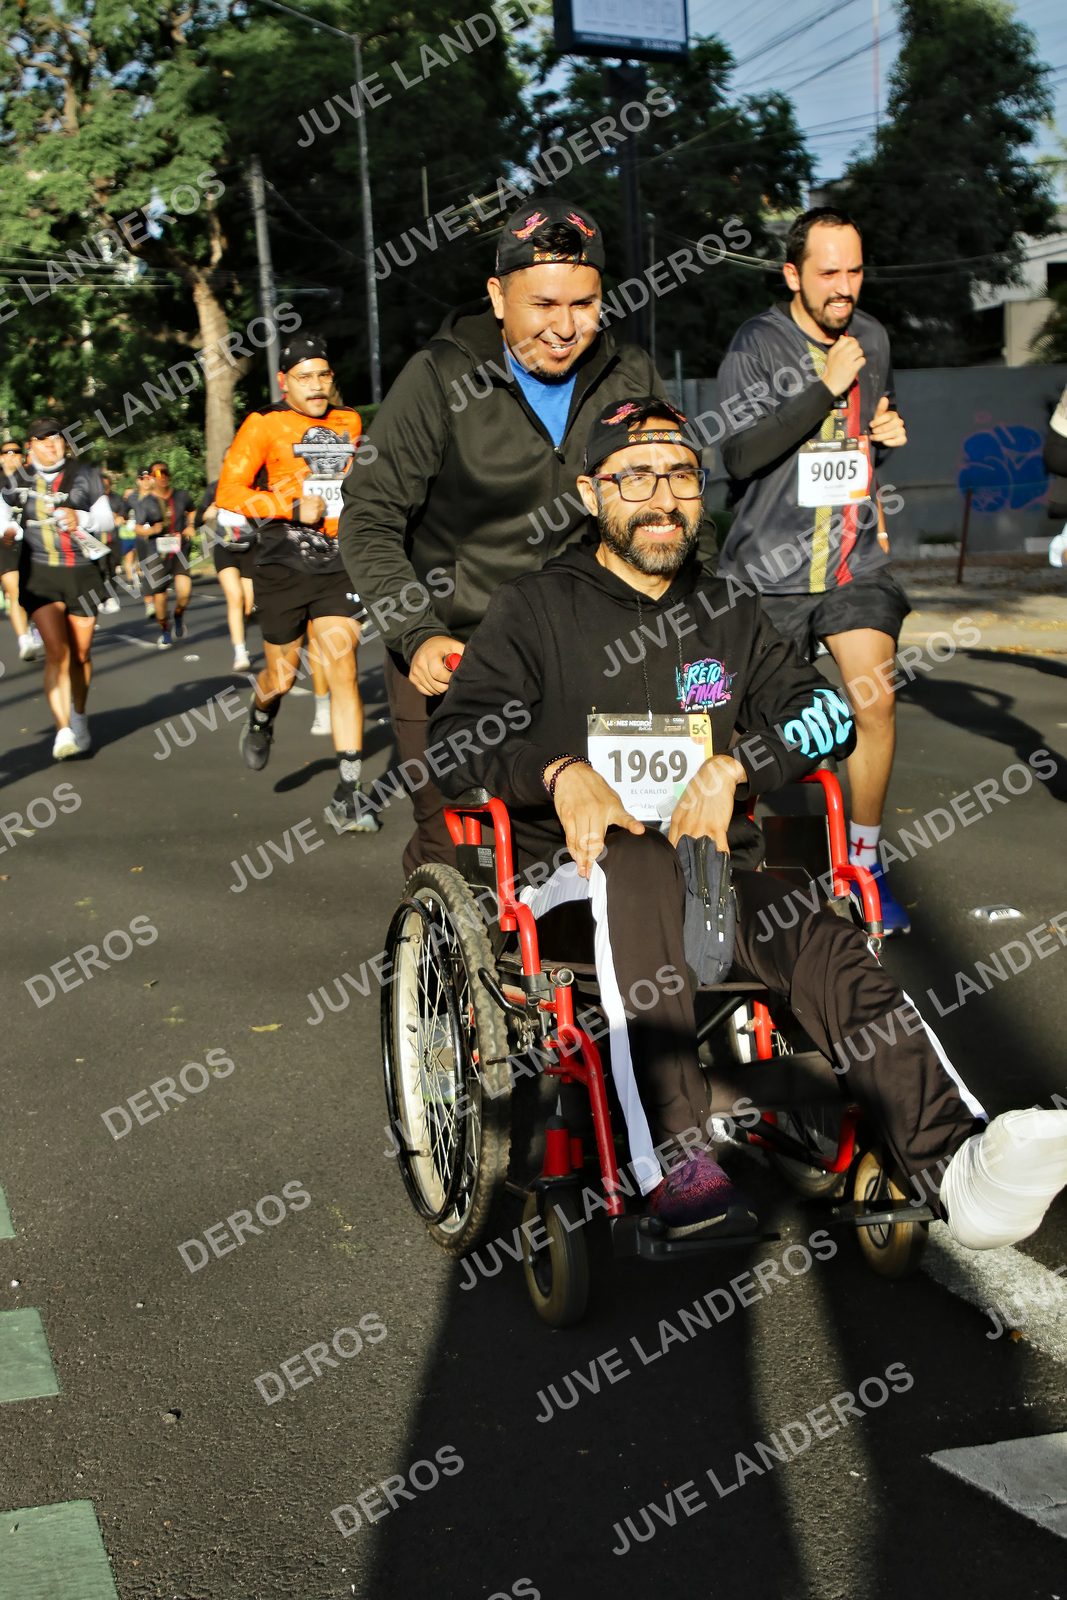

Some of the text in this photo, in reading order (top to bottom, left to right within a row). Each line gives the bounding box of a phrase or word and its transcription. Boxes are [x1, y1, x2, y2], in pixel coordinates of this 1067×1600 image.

[811, 460, 858, 482] 9005
[686, 663, 721, 691] RETO
[686, 680, 724, 705] FINAL
[692, 724, 708, 735] 5K
[607, 749, 688, 783] 1969
